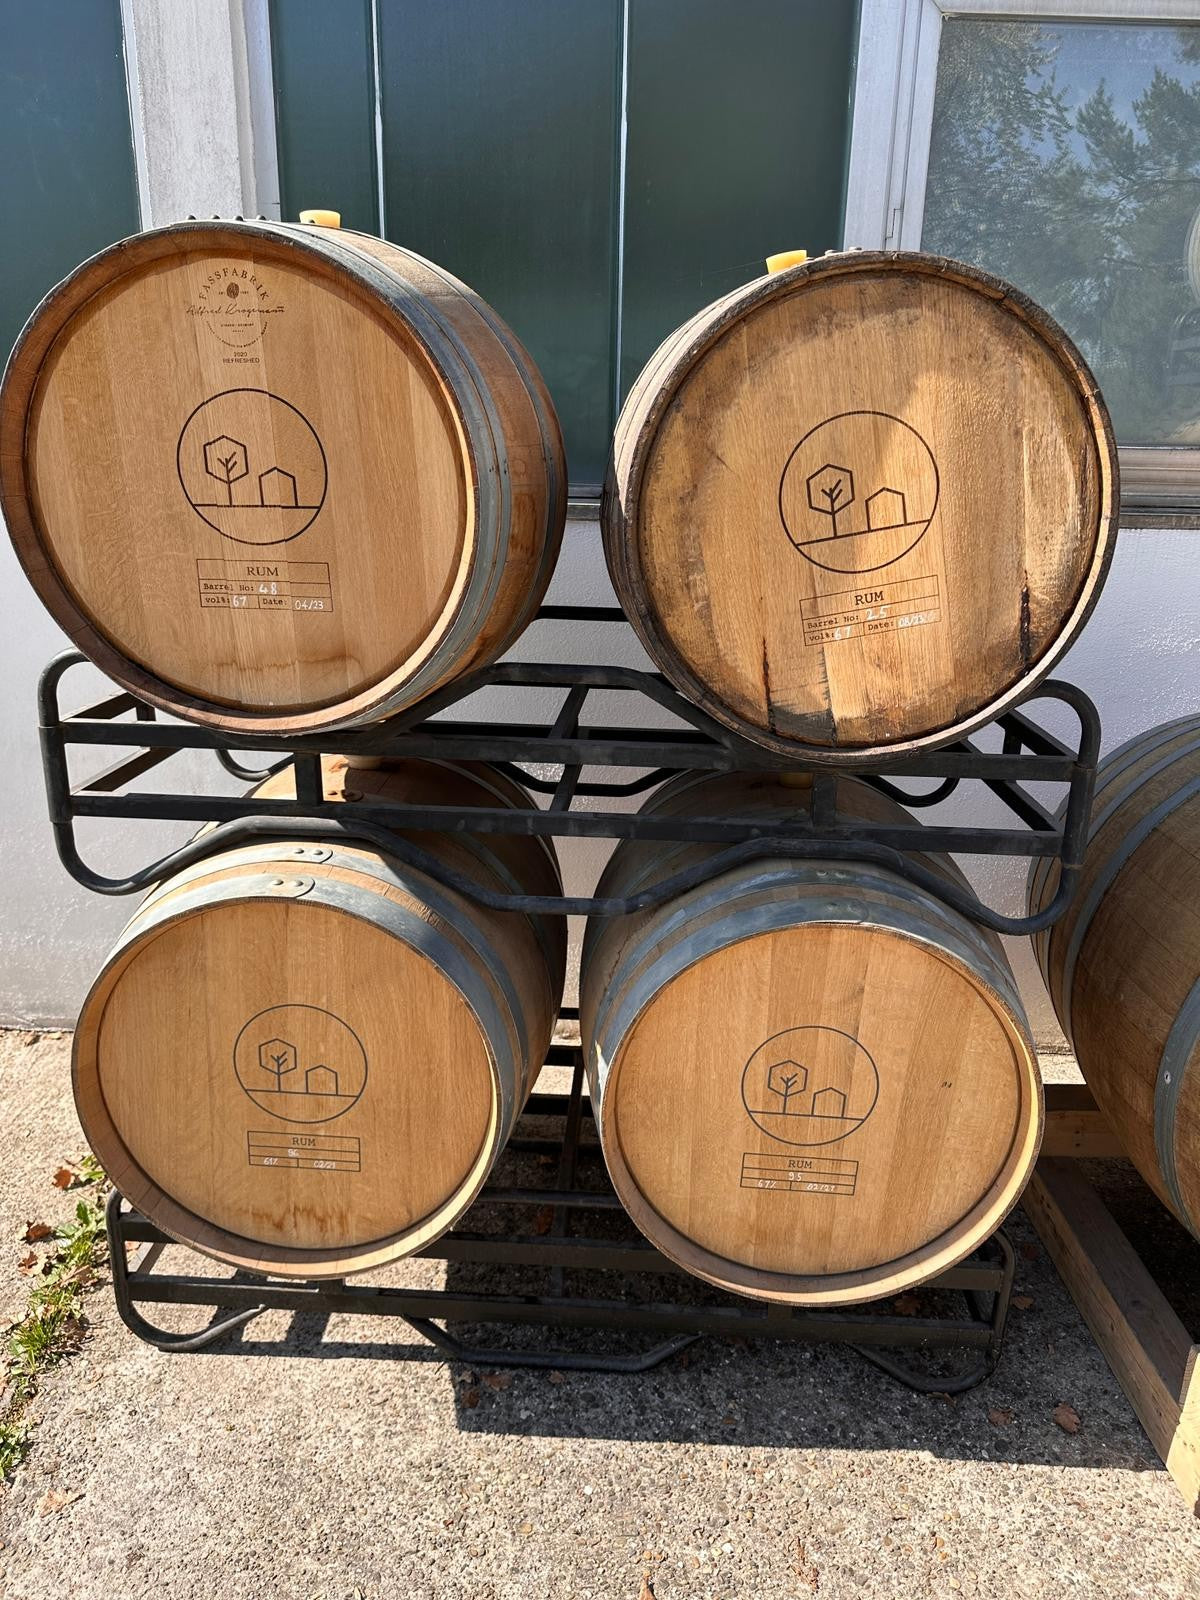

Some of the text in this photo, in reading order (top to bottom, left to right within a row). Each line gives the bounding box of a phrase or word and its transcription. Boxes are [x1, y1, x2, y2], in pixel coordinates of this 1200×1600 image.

[199, 267, 270, 301] FASSFABRIK
[246, 566, 279, 577] RUM
[203, 582, 278, 595] Barrel No: 48
[232, 596, 247, 608] 67
[294, 599, 325, 610] 04/23
[854, 590, 885, 606] RUM
[807, 605, 892, 629] Barrel No: 25
[867, 621, 894, 631] Date:
[292, 1136, 317, 1147] RUM
[788, 1159, 813, 1169] RUM
[788, 1171, 804, 1182] 95
